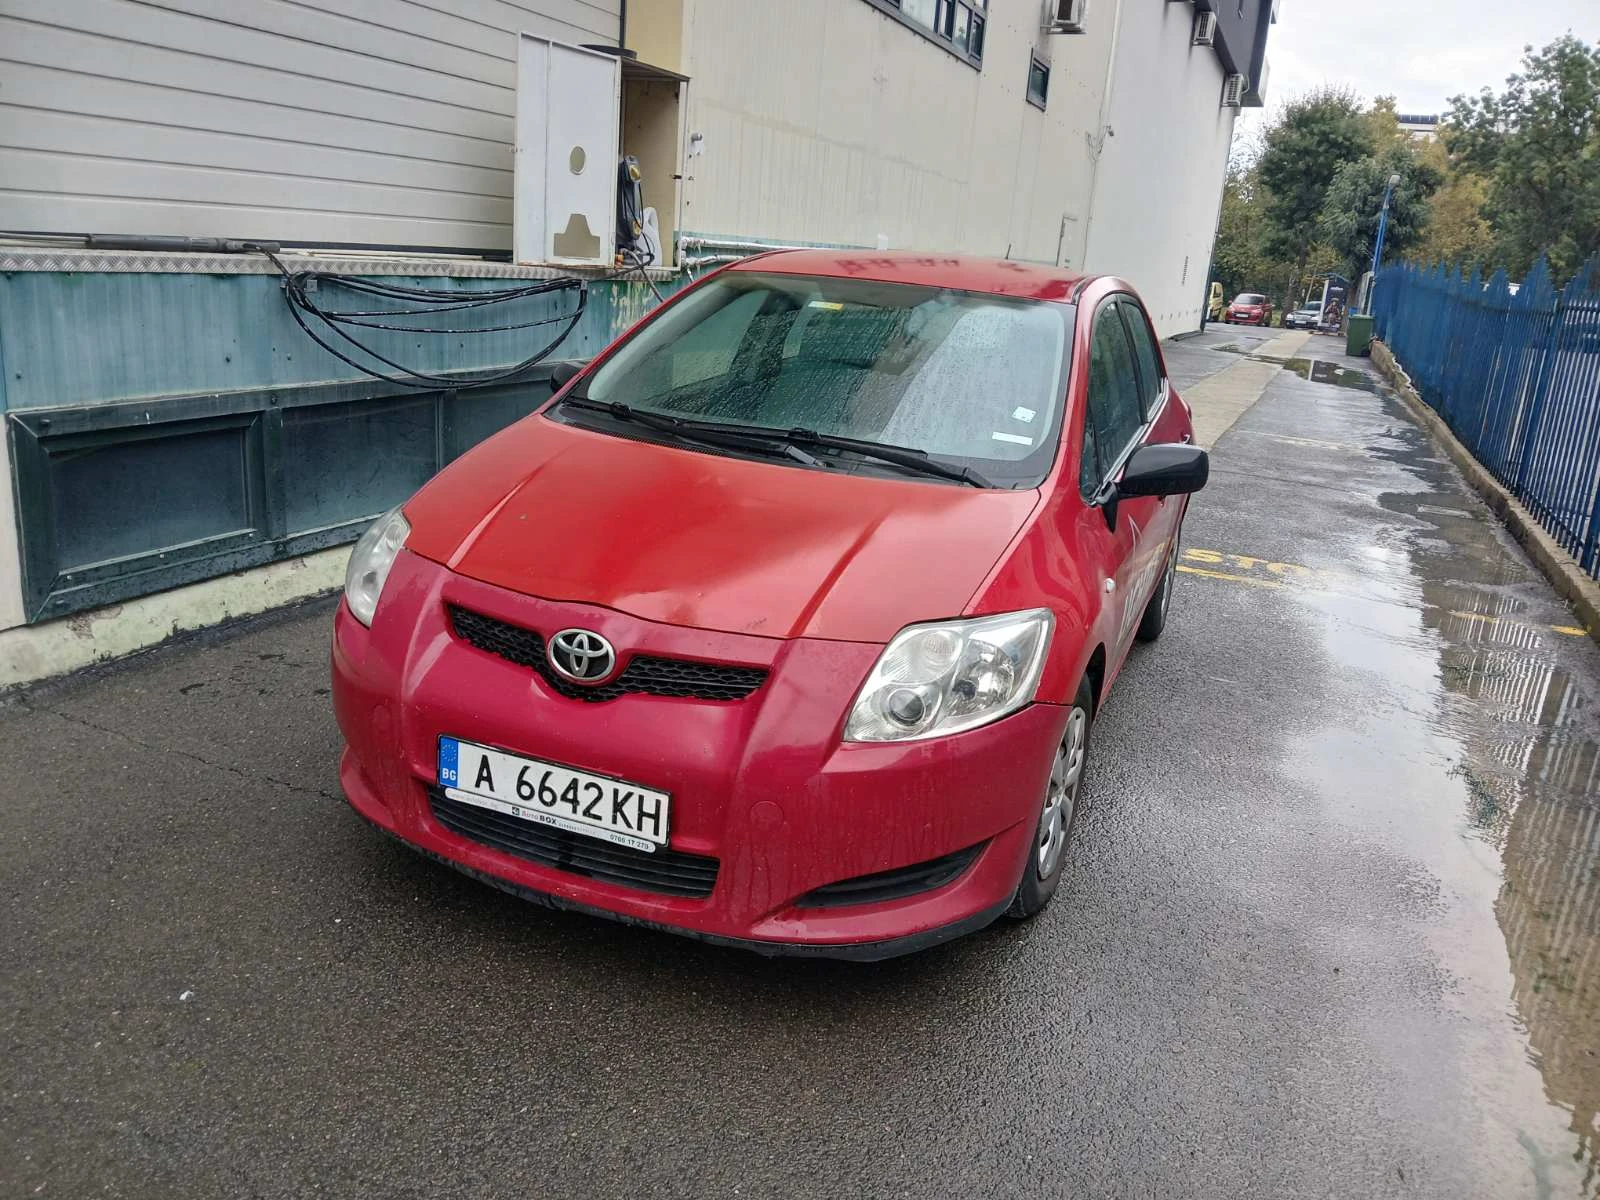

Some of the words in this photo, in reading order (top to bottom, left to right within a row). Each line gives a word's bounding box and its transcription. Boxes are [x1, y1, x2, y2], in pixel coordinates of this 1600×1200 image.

[442, 767, 457, 781] BG
[474, 754, 495, 792] A
[539, 815, 558, 825] BOX
